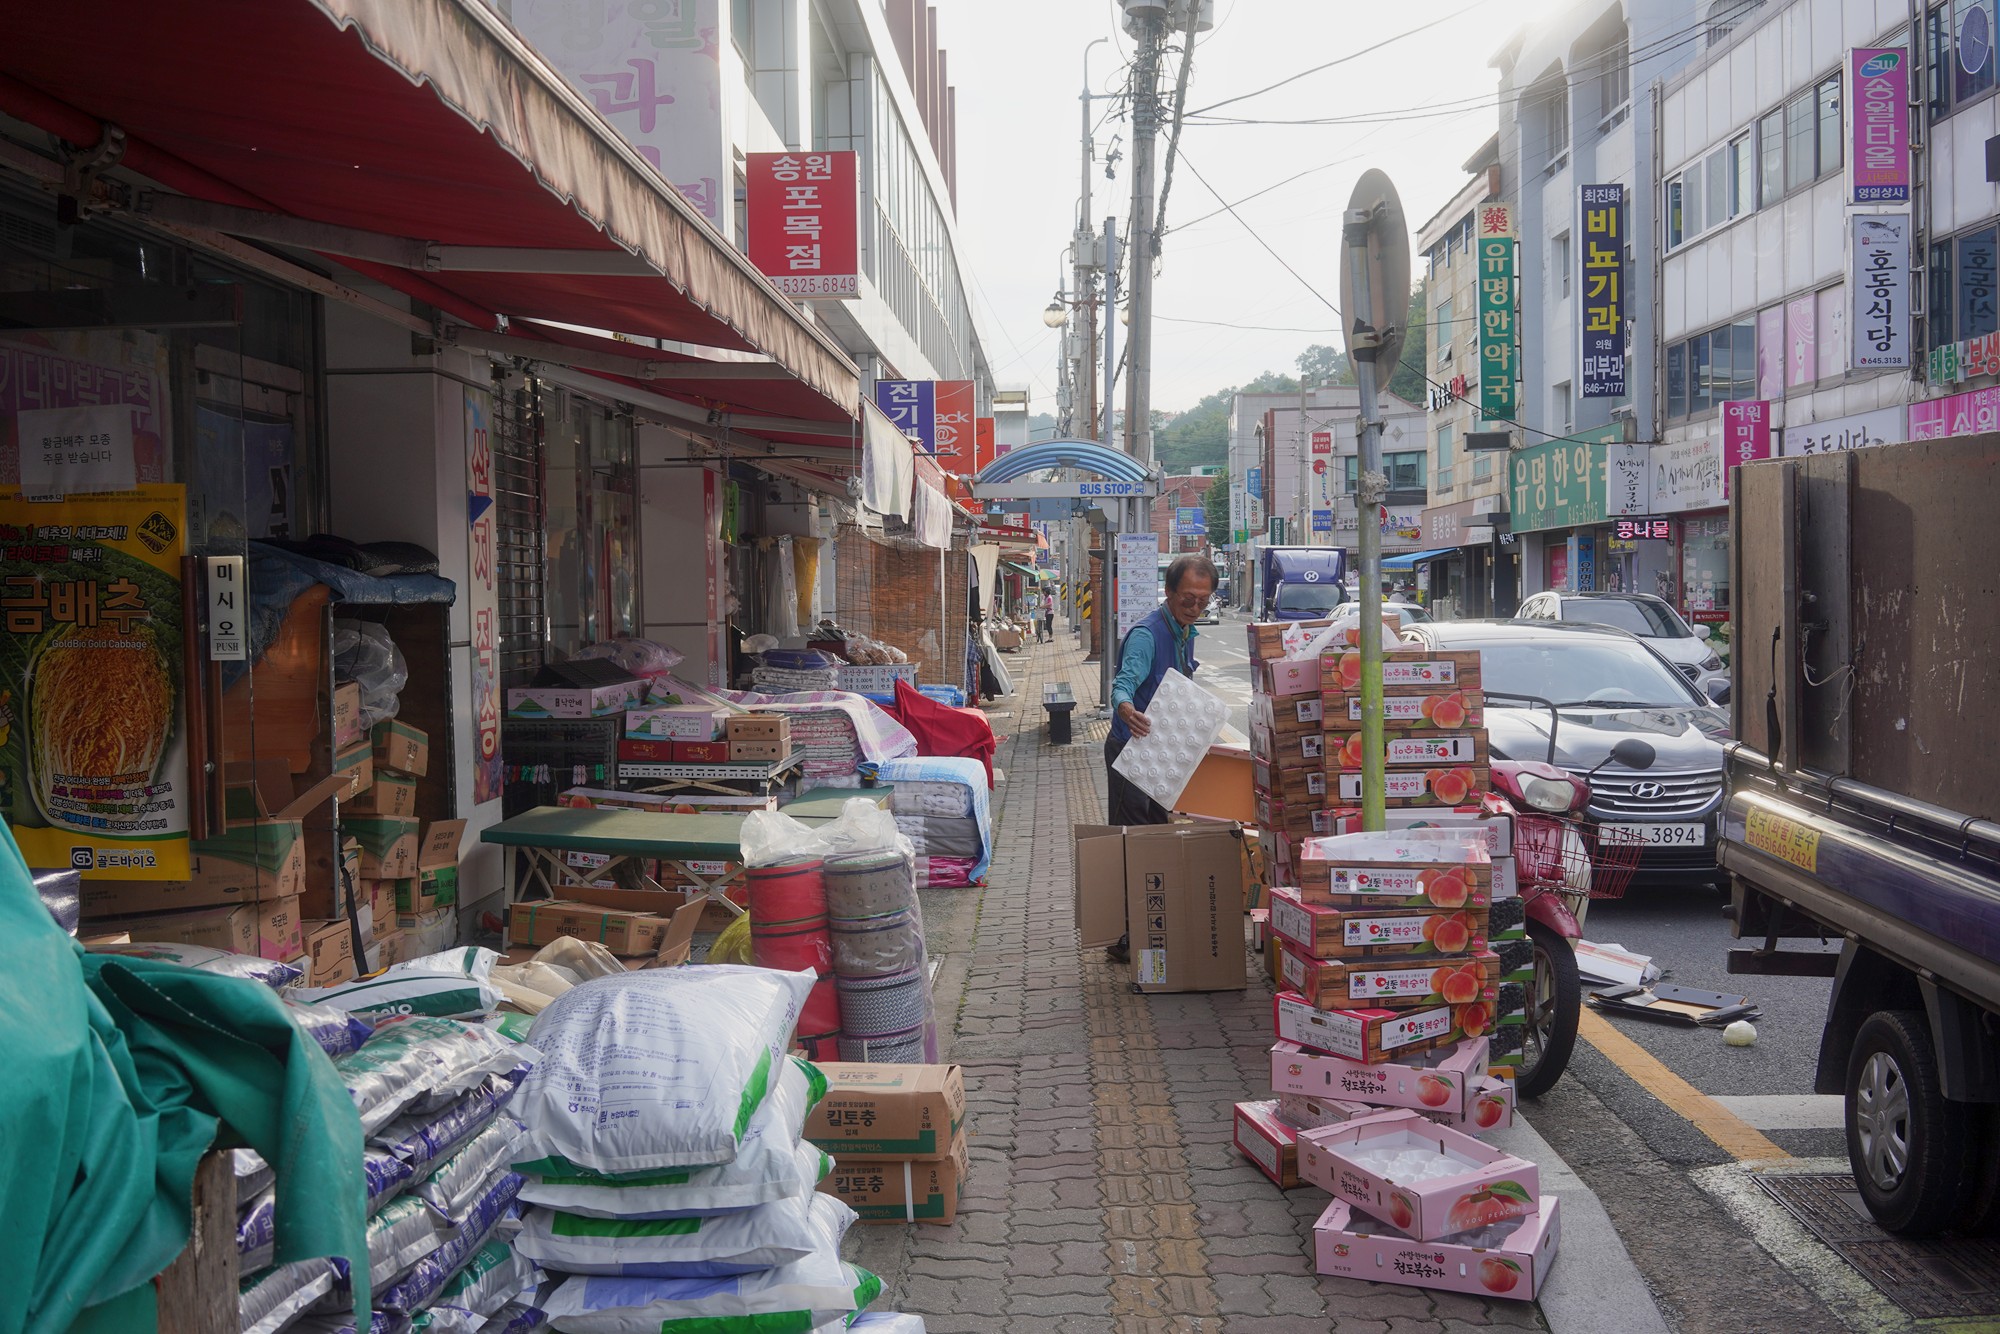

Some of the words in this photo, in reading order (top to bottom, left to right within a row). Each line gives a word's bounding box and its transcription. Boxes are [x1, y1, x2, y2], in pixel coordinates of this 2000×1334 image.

[1864, 78, 1900, 169] 송월타올
[772, 155, 831, 181] 송원
[1584, 188, 1621, 203] 최진화
[1858, 187, 1904, 199] 영일상사
[783, 186, 822, 270] 포목점
[1586, 207, 1620, 335] 비뇨기과
[1865, 250, 1897, 351] 호동식당
[1482, 243, 1512, 404] 유명한약국
[1595, 339, 1612, 350] 의원
[1584, 355, 1624, 380] 피부과
[1584, 382, 1624, 393] 646-7177
[1729, 405, 1762, 422] 여원
[42, 435, 85, 449] 황금배추
[89, 433, 111, 446] 모종
[43, 453, 63, 465] 주문
[68, 450, 112, 464] 받습니다
[1080, 483, 1103, 495] BUS
[1104, 483, 1132, 494] STOP
[38, 525, 71, 540] 배추의
[74, 525, 129, 541] 세대교체!!
[1617, 520, 1669, 539] 콩나물
[72, 548, 102, 561] 배추!!
[216, 563, 235, 636] 미시오
[472, 428, 497, 762] 산지직송
[52, 639, 84, 650] GoldBio
[86, 639, 107, 649] Gold
[108, 639, 147, 650] Cabbage
[215, 642, 239, 652] PUSH
[1651, 827, 1696, 844] 3894
[1748, 808, 1817, 851] 전국(화물)운수
[97, 855, 157, 868] 골드바이오
[1383, 878, 1414, 888] 복숭아
[1393, 926, 1421, 936] 복숭아
[1400, 978, 1429, 988] 복숭아
[1425, 1016, 1447, 1030] 복숭아
[1341, 1077, 1386, 1094] 청도복숭아
[826, 1109, 876, 1127] 킬토충
[922, 1106, 929, 1115] 3
[930, 1170, 937, 1178] 3
[835, 1175, 885, 1193] 킬토충
[1466, 1215, 1483, 1225] YOU
[1394, 1259, 1446, 1278] 청도복숭아
